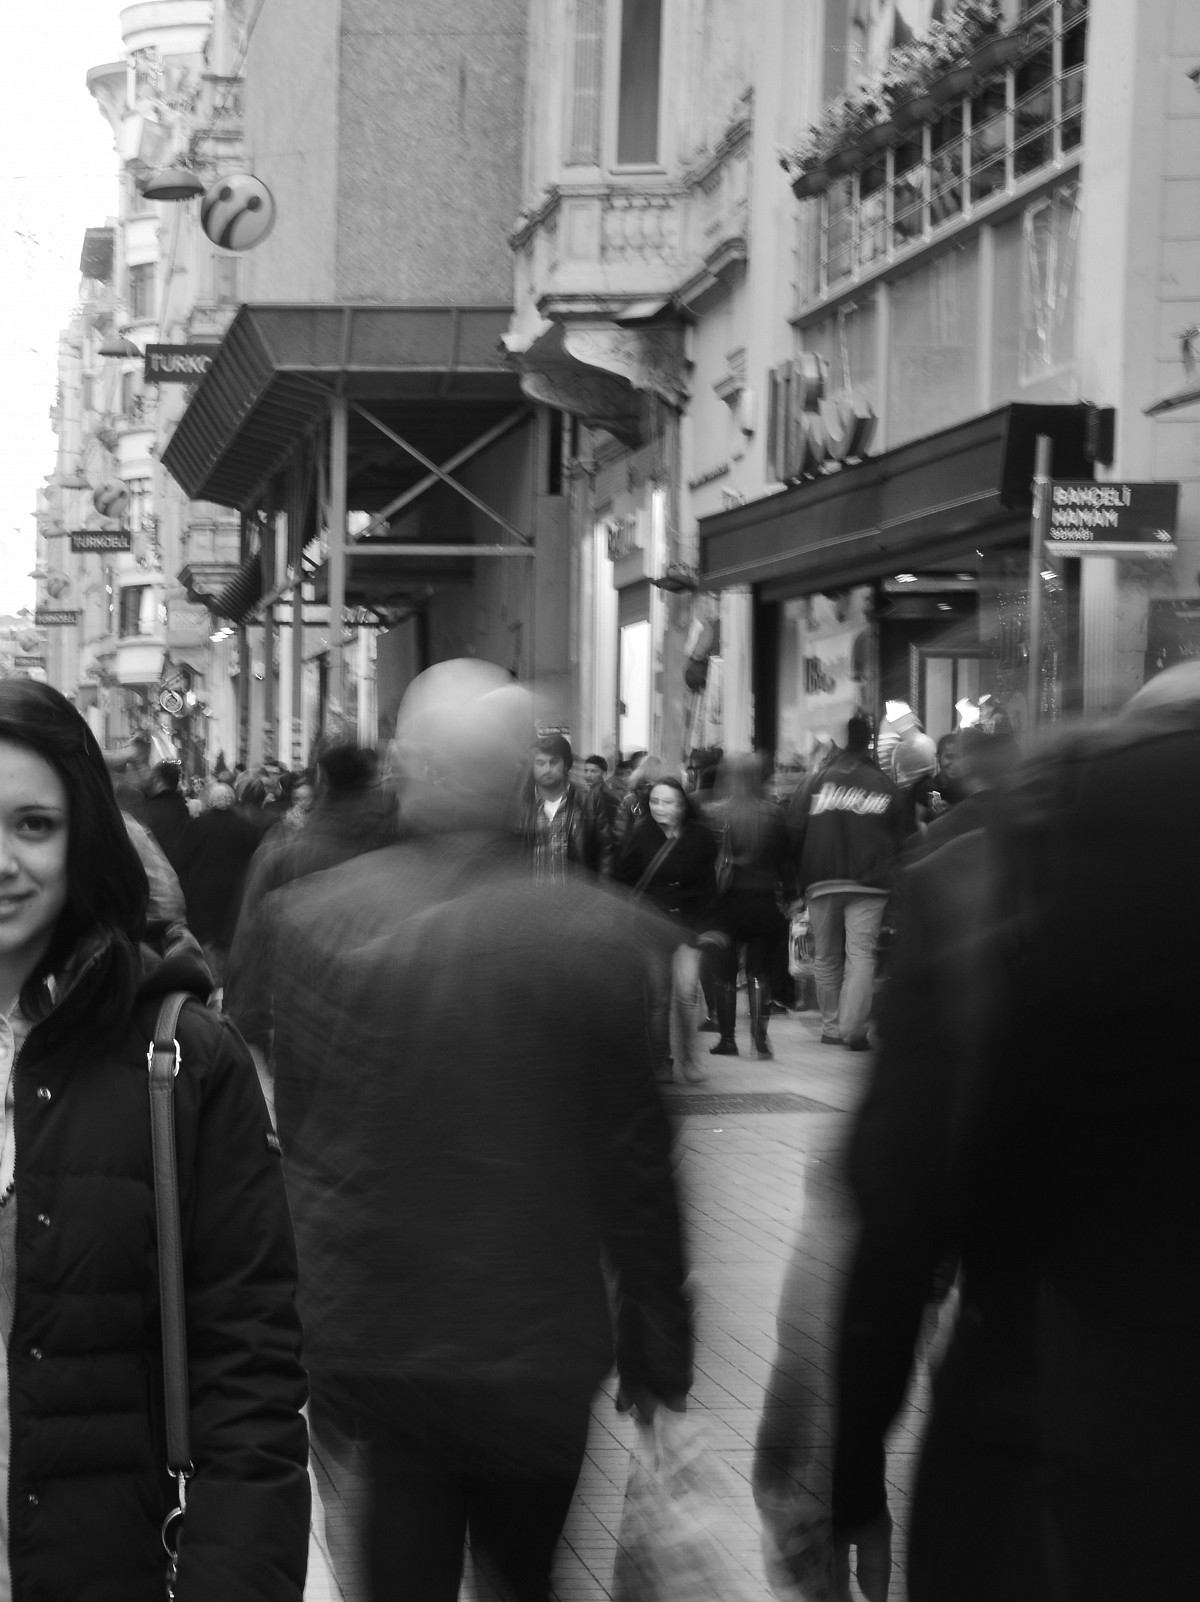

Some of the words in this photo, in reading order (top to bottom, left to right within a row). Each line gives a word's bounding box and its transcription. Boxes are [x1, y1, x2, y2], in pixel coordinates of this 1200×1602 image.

[148, 352, 213, 374] TURKC
[1051, 508, 1119, 528] HAMAM
[72, 534, 131, 548] TURKCELL
